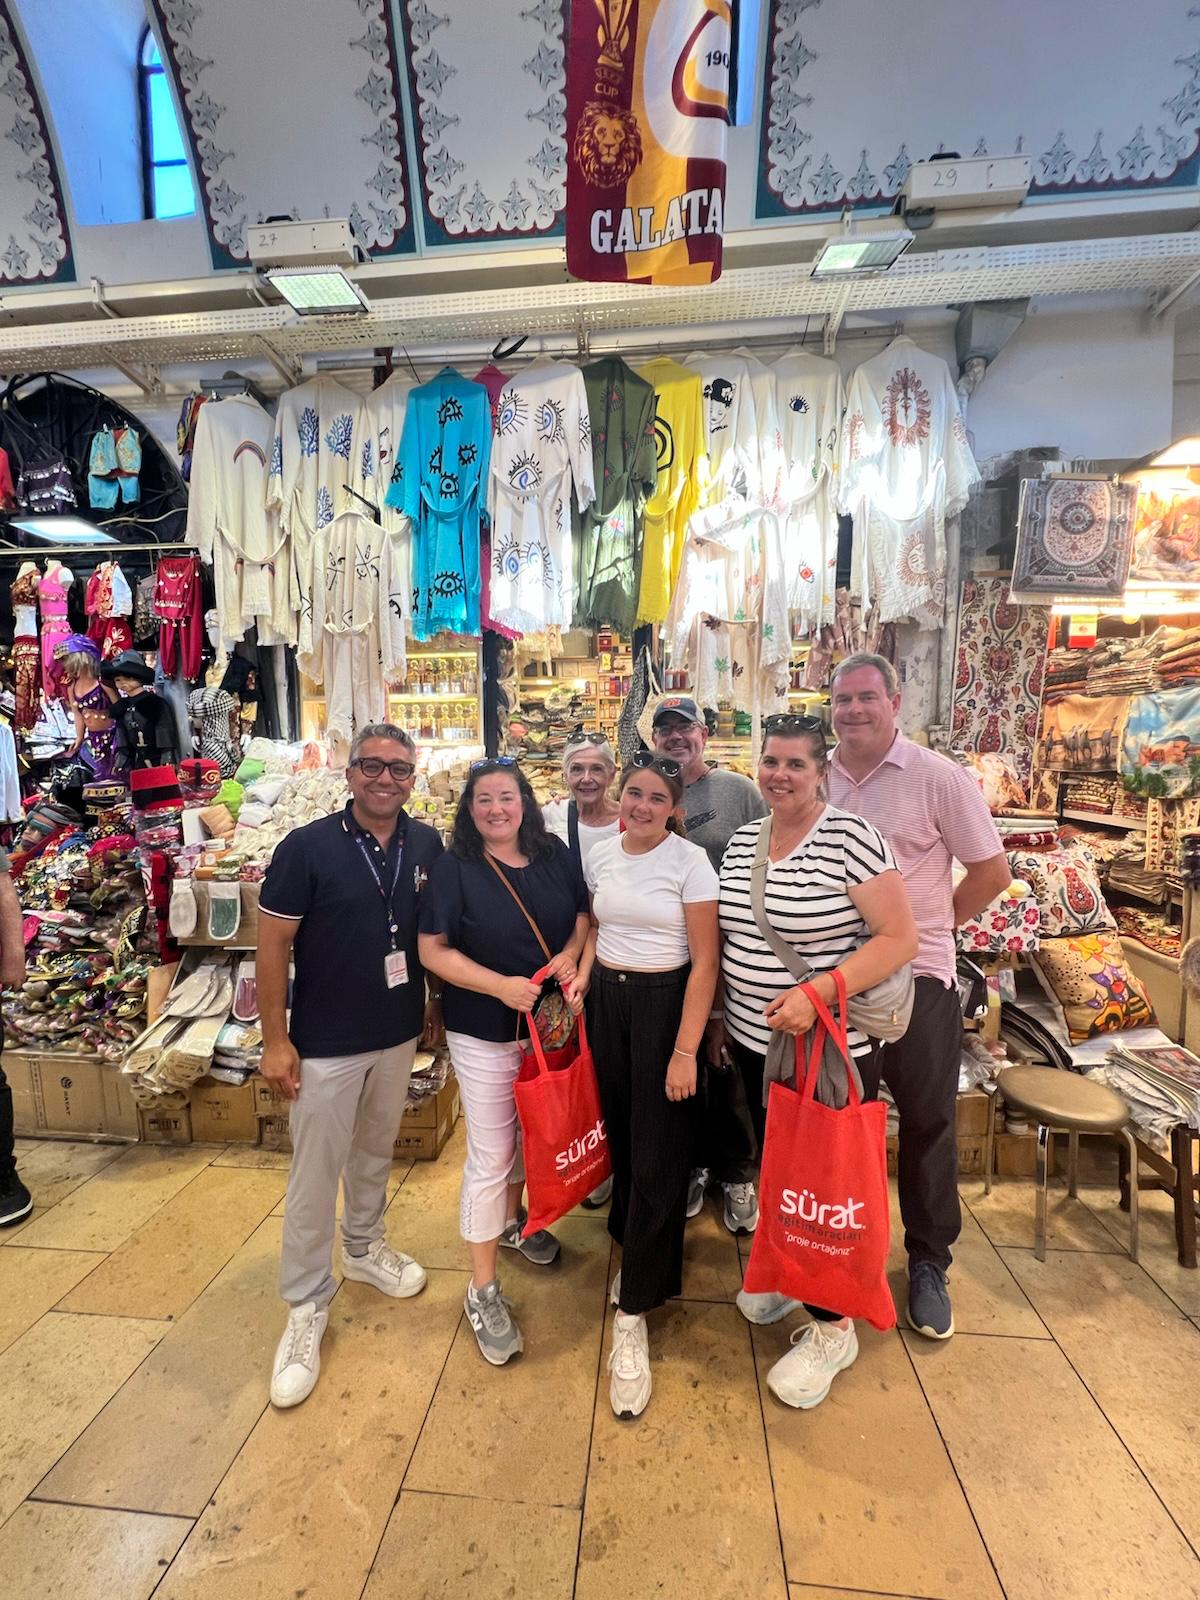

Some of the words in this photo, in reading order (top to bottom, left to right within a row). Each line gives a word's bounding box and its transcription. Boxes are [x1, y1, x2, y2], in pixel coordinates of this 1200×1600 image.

[594, 82, 619, 97] CUP
[934, 168, 957, 187] 29
[590, 187, 722, 254] GALATA
[259, 233, 278, 246] 27
[555, 1119, 607, 1171] sürat
